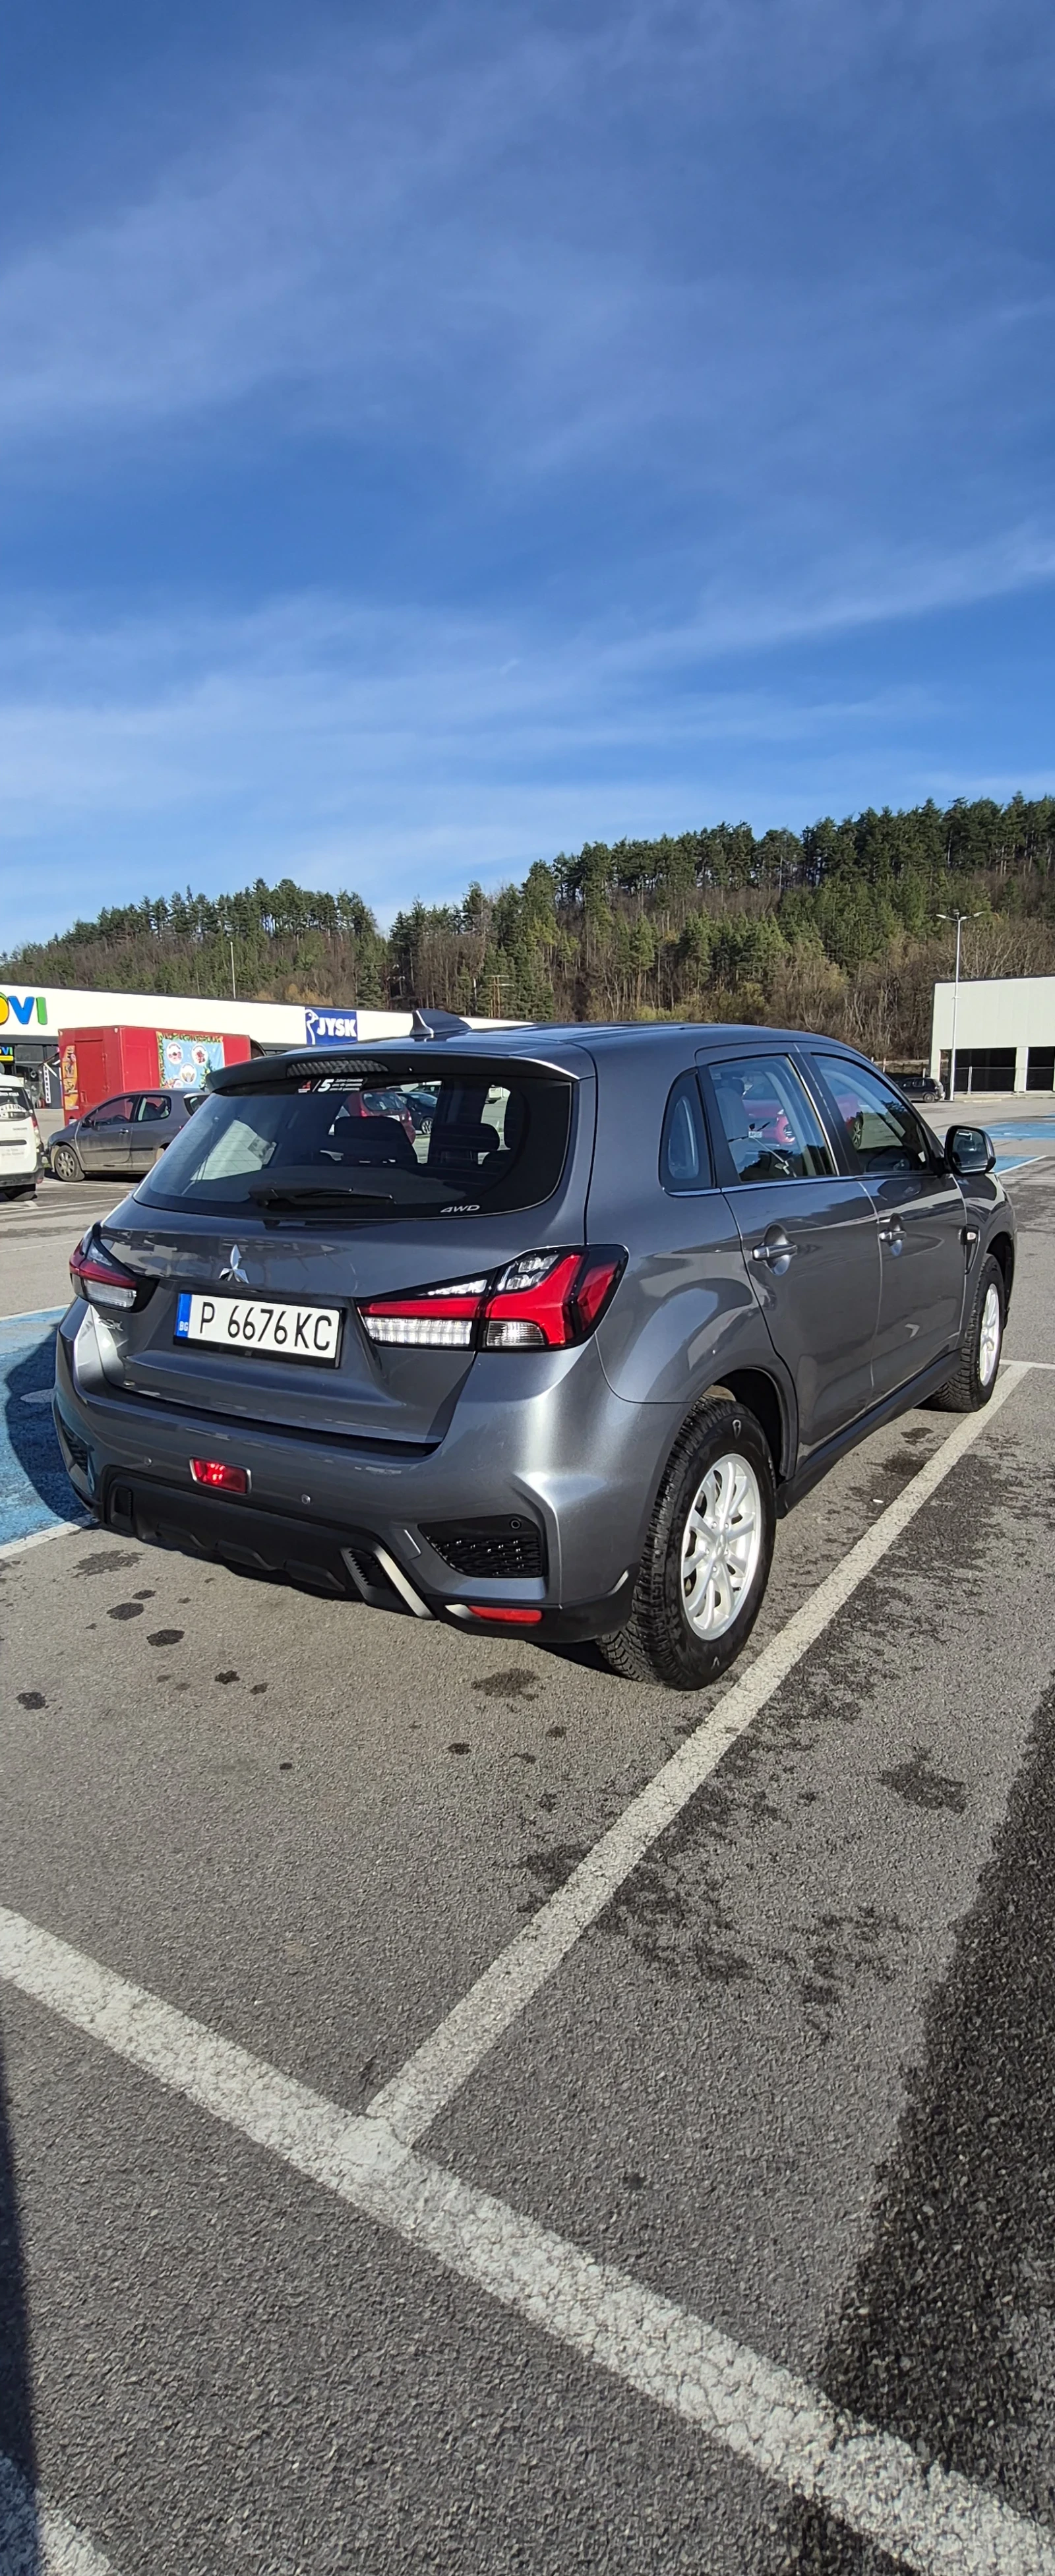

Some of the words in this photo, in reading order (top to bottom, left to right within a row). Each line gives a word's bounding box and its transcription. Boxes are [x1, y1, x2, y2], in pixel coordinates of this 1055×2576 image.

[316, 1017, 357, 1037] JYSK
[0, 1046, 13, 1055] VI
[318, 1079, 334, 1092] 5
[440, 1205, 480, 1213] 4WD
[200, 1302, 215, 1334] P
[179, 1321, 189, 1332] BG
